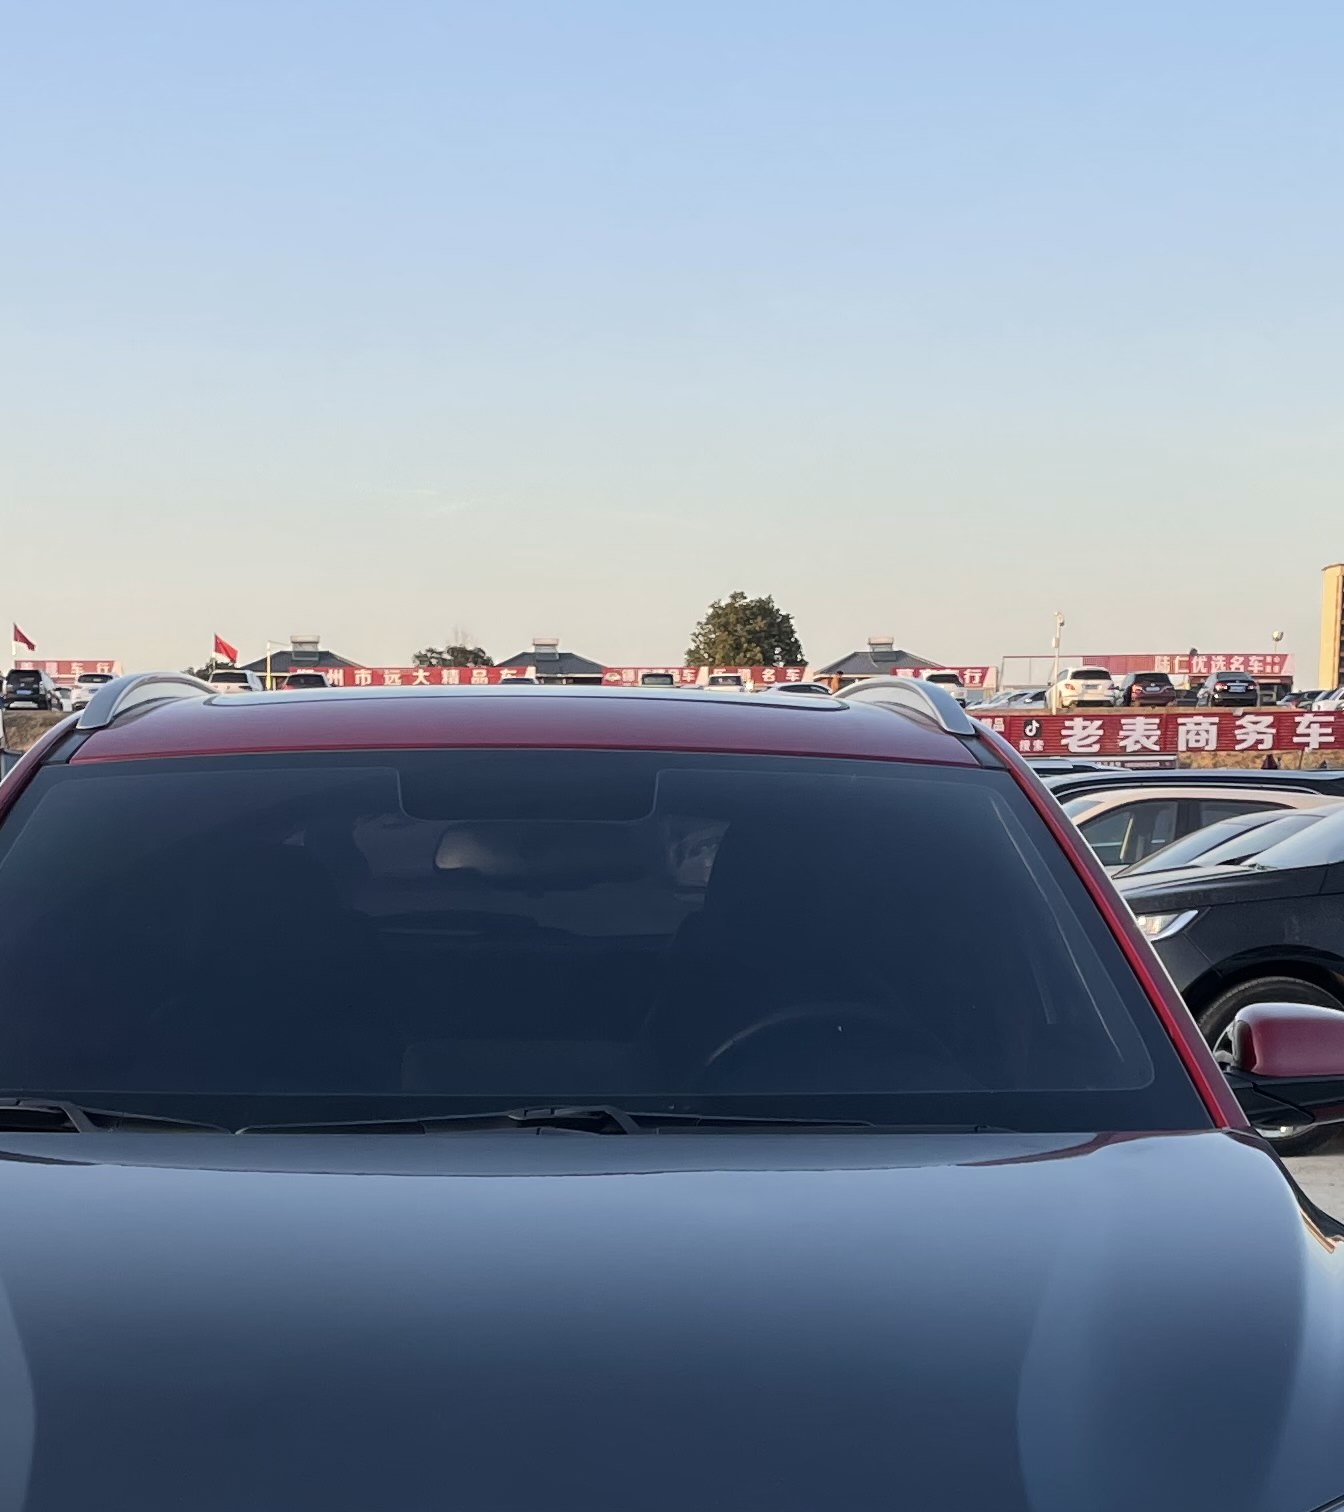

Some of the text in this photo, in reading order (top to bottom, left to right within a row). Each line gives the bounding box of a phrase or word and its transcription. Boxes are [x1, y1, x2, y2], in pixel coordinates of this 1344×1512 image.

[1060, 713, 1335, 753] 老表商务车
